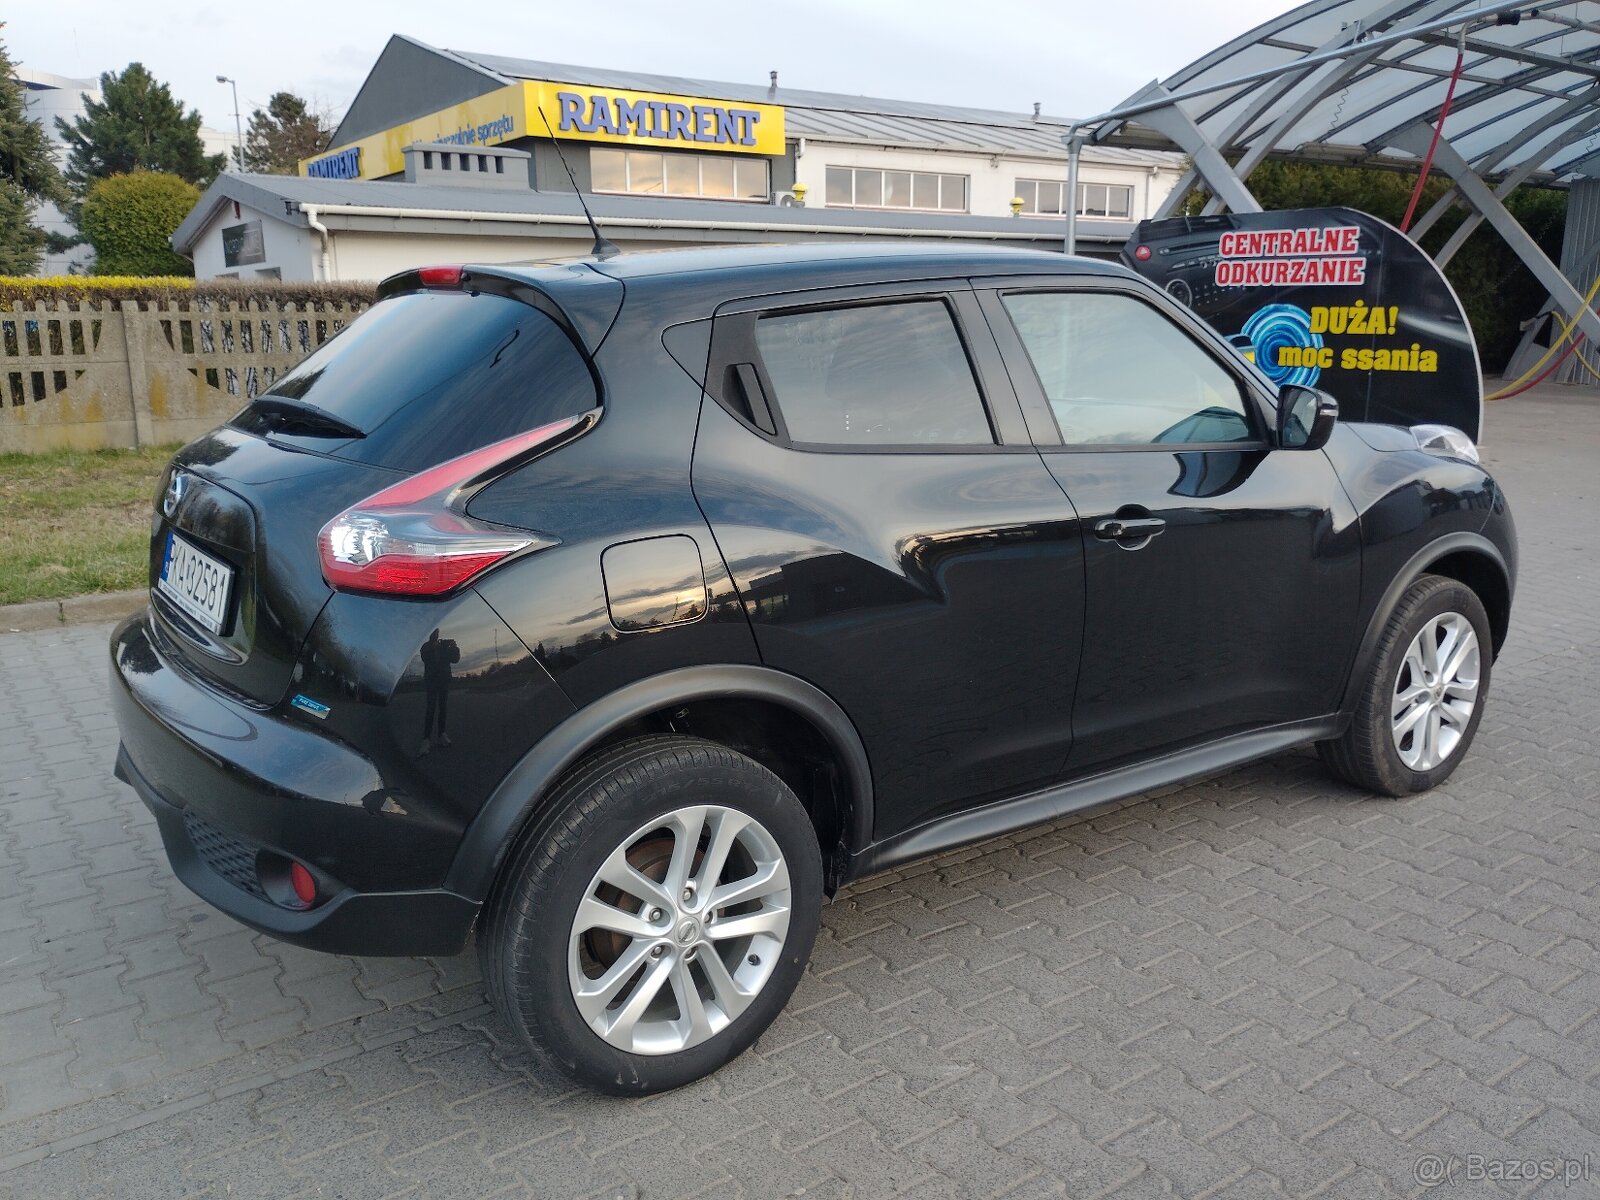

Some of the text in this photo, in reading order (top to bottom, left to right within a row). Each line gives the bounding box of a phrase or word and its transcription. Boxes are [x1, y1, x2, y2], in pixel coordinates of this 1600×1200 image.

[477, 114, 514, 146] sprzętu
[558, 92, 760, 146] RAMIRENT
[1219, 226, 1360, 257] CENTRALNE
[1215, 258, 1366, 287] ODKURZANIE
[1309, 299, 1399, 335] DUŻA!
[1278, 343, 1438, 372] moc ssania
